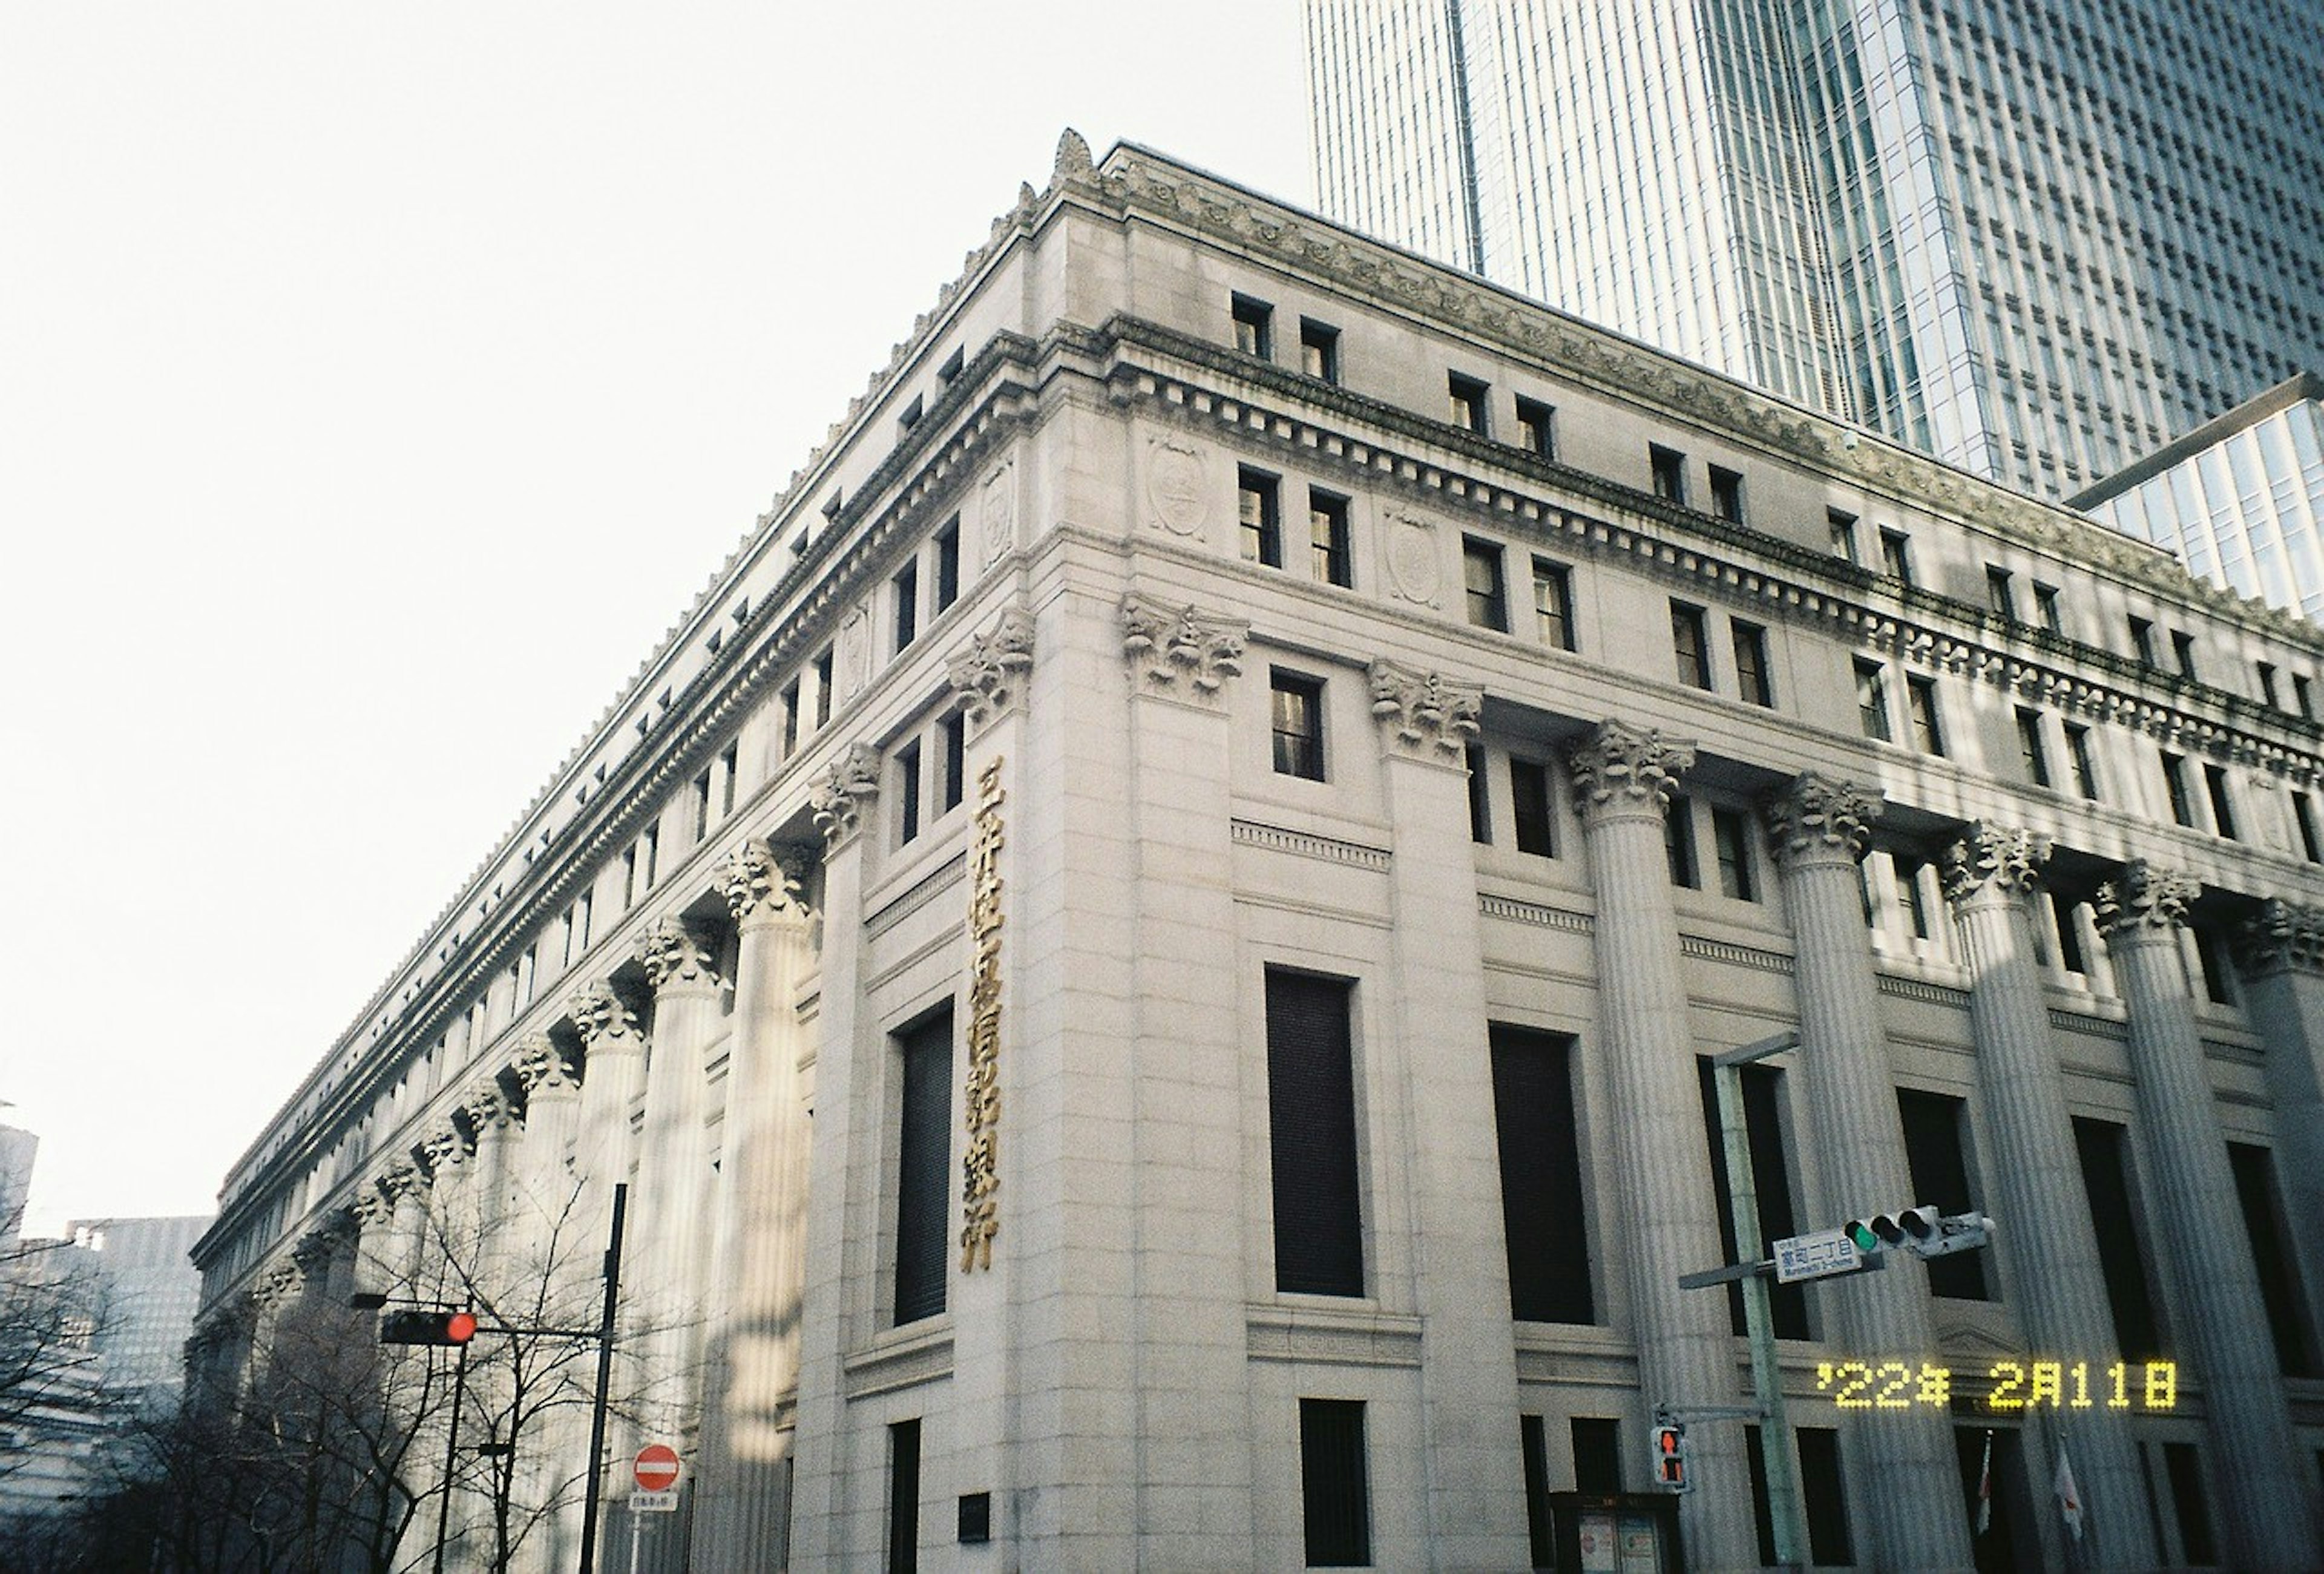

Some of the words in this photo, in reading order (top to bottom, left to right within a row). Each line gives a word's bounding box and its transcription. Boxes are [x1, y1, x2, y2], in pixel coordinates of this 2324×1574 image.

[961, 755, 1005, 1274] 三井住友信託銀行
[1782, 1239, 1852, 1267] 室町二丁目
